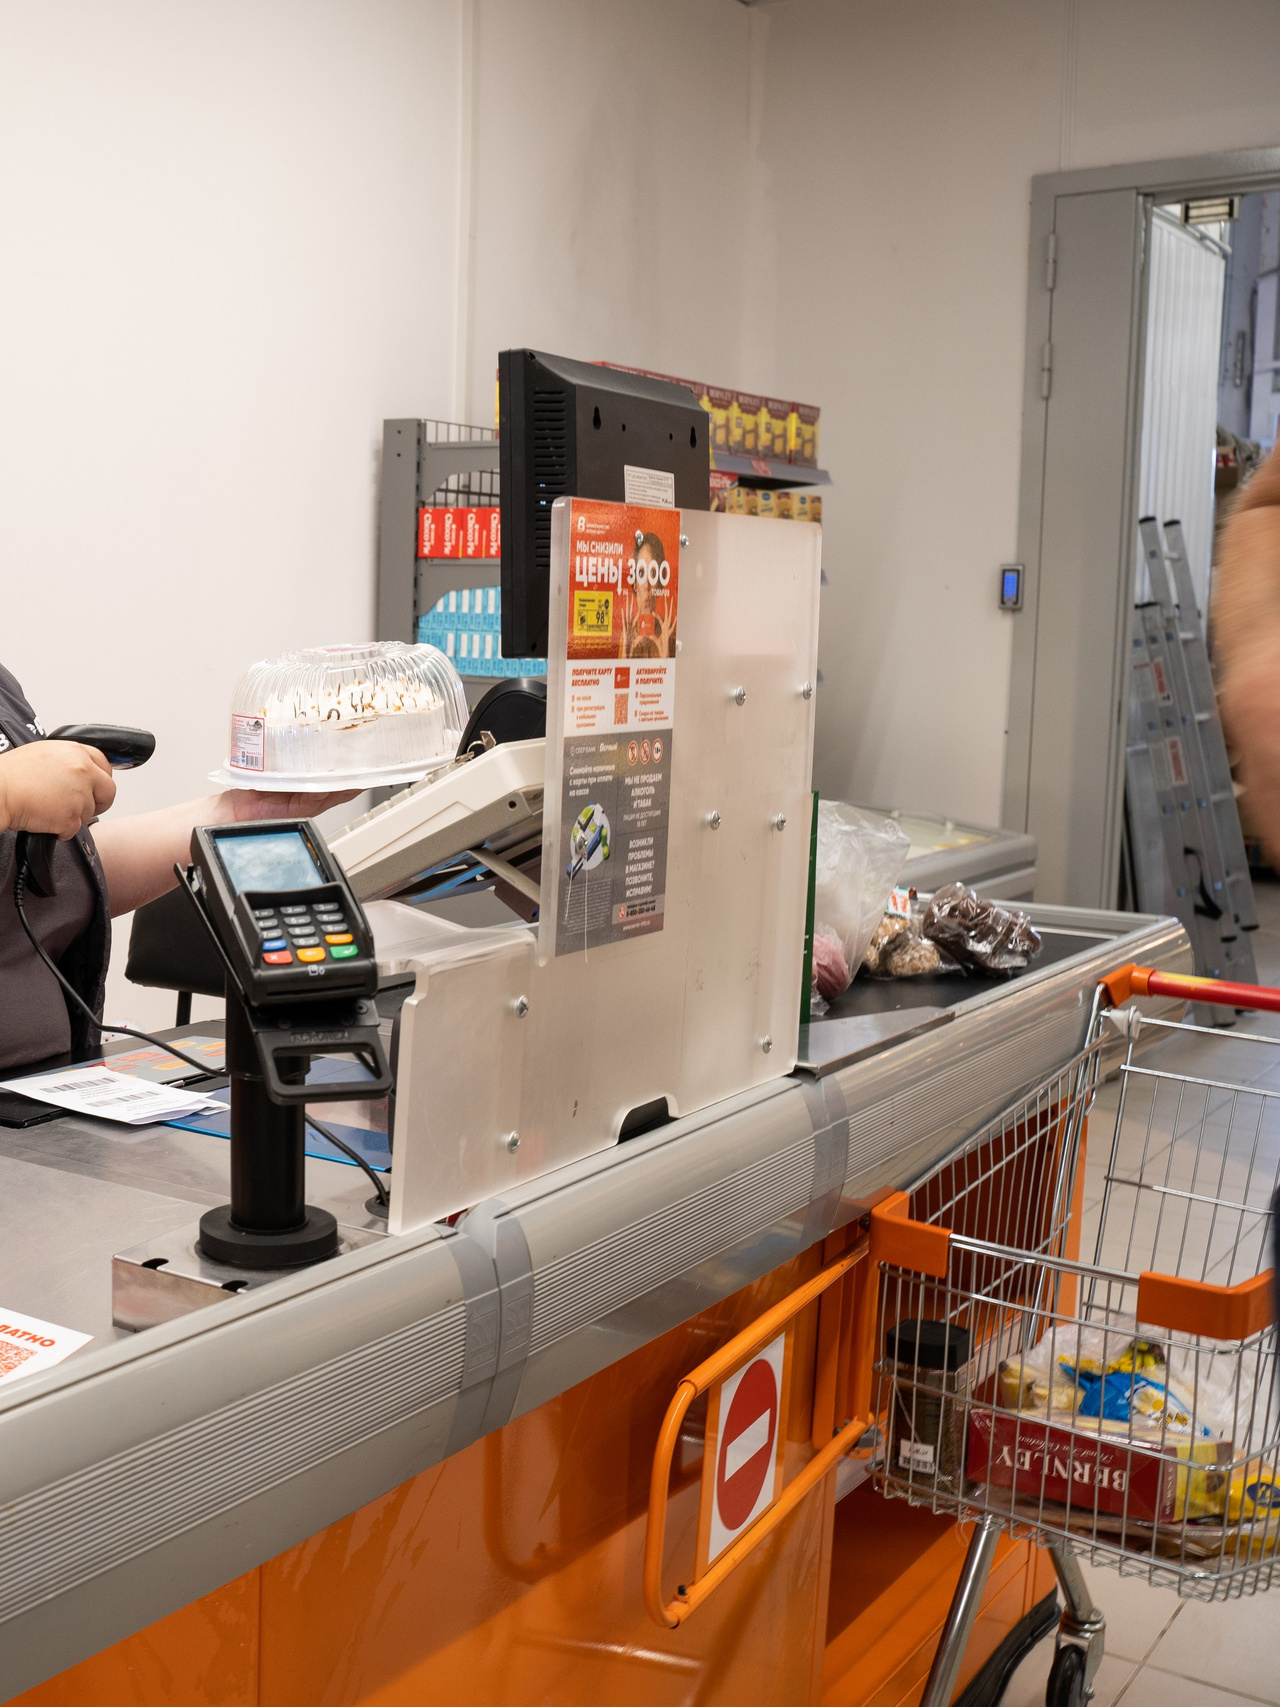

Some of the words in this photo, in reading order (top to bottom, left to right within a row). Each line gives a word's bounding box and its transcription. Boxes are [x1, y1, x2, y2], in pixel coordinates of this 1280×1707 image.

[576, 539, 589, 553] МЫ
[590, 541, 624, 555] СНИЗИЛИ
[575, 555, 623, 596] ЦЕНЫ
[626, 558, 671, 587] 3000
[595, 611, 605, 625] 98
[571, 668, 597, 676] ПОЛУЧИТЕ
[597, 667, 613, 675] КАРТУ
[636, 665, 667, 675] АКТИВИРУЙТЕ
[571, 678, 600, 687] БЕСПЛАТНО
[569, 764, 593, 776] Снимайте
[624, 776, 634, 786] МЫ
[634, 775, 641, 785] НЕ
[640, 773, 663, 784] ПРОДАЕМ
[631, 785, 655, 797] АЛКОГОЛЬ
[638, 798, 652, 808] ТАБАК
[629, 837, 654, 849] ВОЗНИКЛИ
[627, 848, 654, 861] ПРОБЛЕМЫ
[629, 860, 655, 874] МАГАЗИНЕ?
[994, 1444, 1129, 1493] BERNLEY
